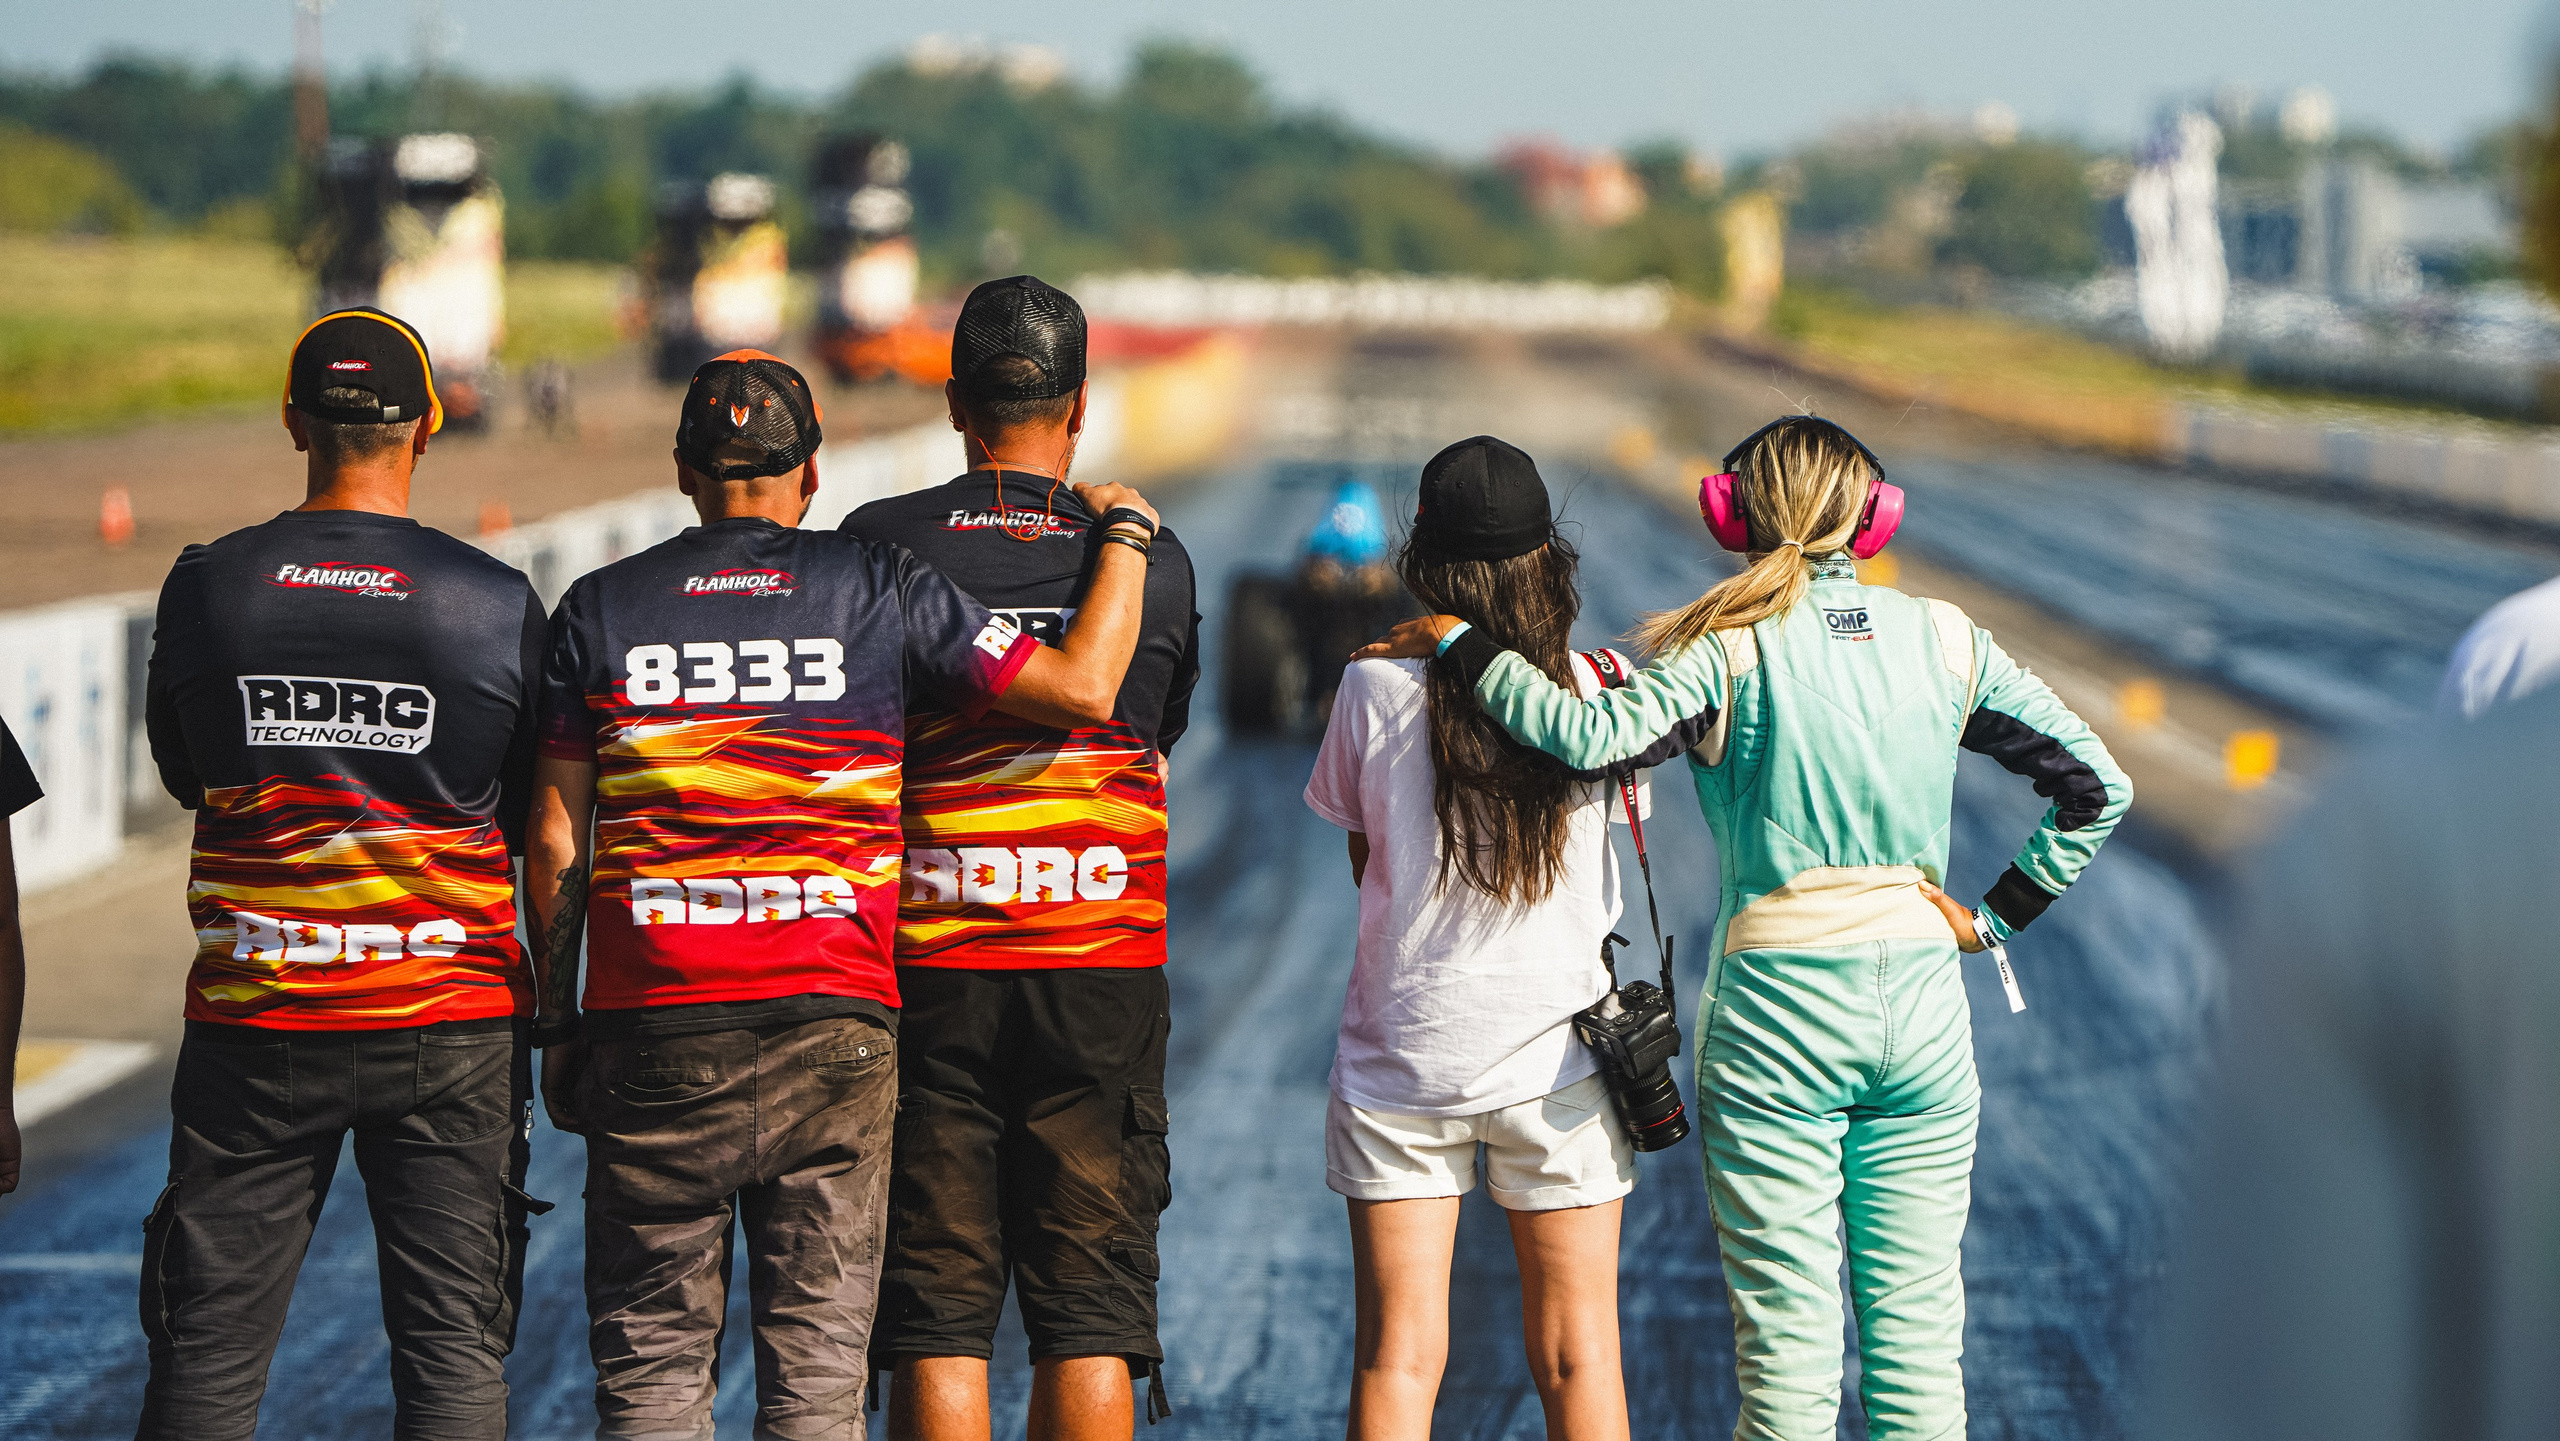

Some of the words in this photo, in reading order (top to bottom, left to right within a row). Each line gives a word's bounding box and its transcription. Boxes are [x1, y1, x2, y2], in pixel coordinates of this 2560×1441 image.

[947, 509, 1060, 527] FLAMHOLC
[1027, 526, 1076, 538] Racing
[276, 563, 398, 587] FLAMHOLC
[683, 573, 782, 592] FLAMHOLC
[358, 587, 409, 600] Racing
[751, 587, 793, 597] Racing
[1826, 611, 1869, 629] OMP
[625, 638, 846, 706] 8333
[243, 680, 430, 730] RDRC
[251, 727, 425, 749] TECHNOLOGY
[907, 846, 1128, 903] RDRC
[631, 875, 857, 926] RDRC
[228, 911, 467, 963] RDRC
